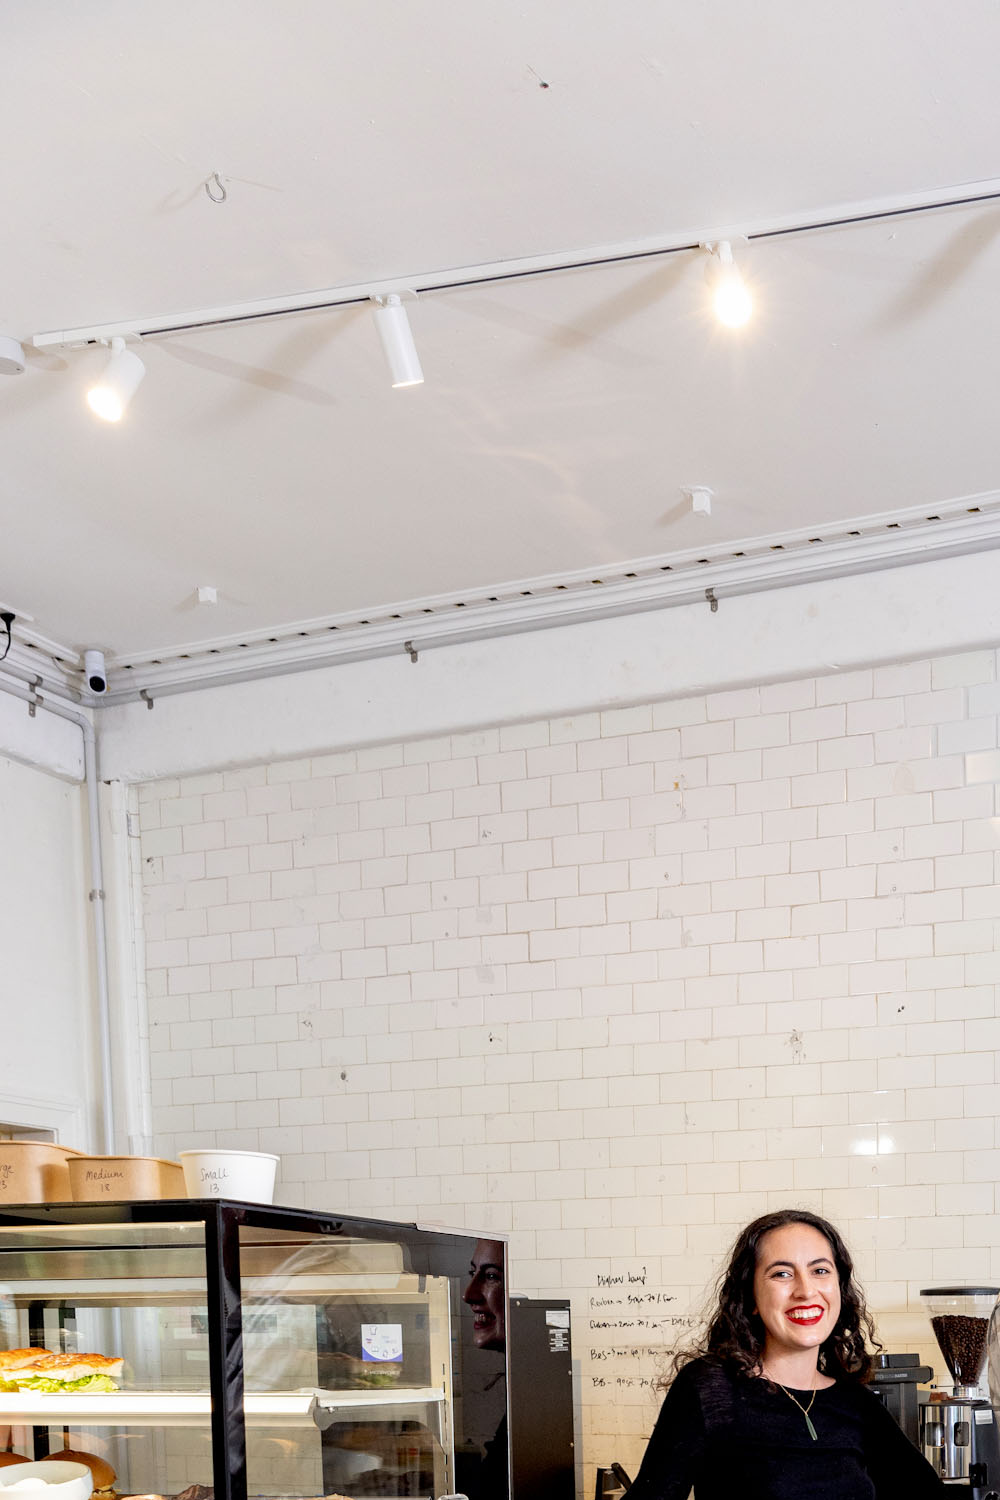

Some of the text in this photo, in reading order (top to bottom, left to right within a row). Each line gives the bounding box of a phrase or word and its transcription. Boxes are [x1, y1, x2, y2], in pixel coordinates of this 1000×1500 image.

[86, 1168, 124, 1181] Medium
[200, 1167, 230, 1182] Small
[209, 1183, 220, 1194] 13
